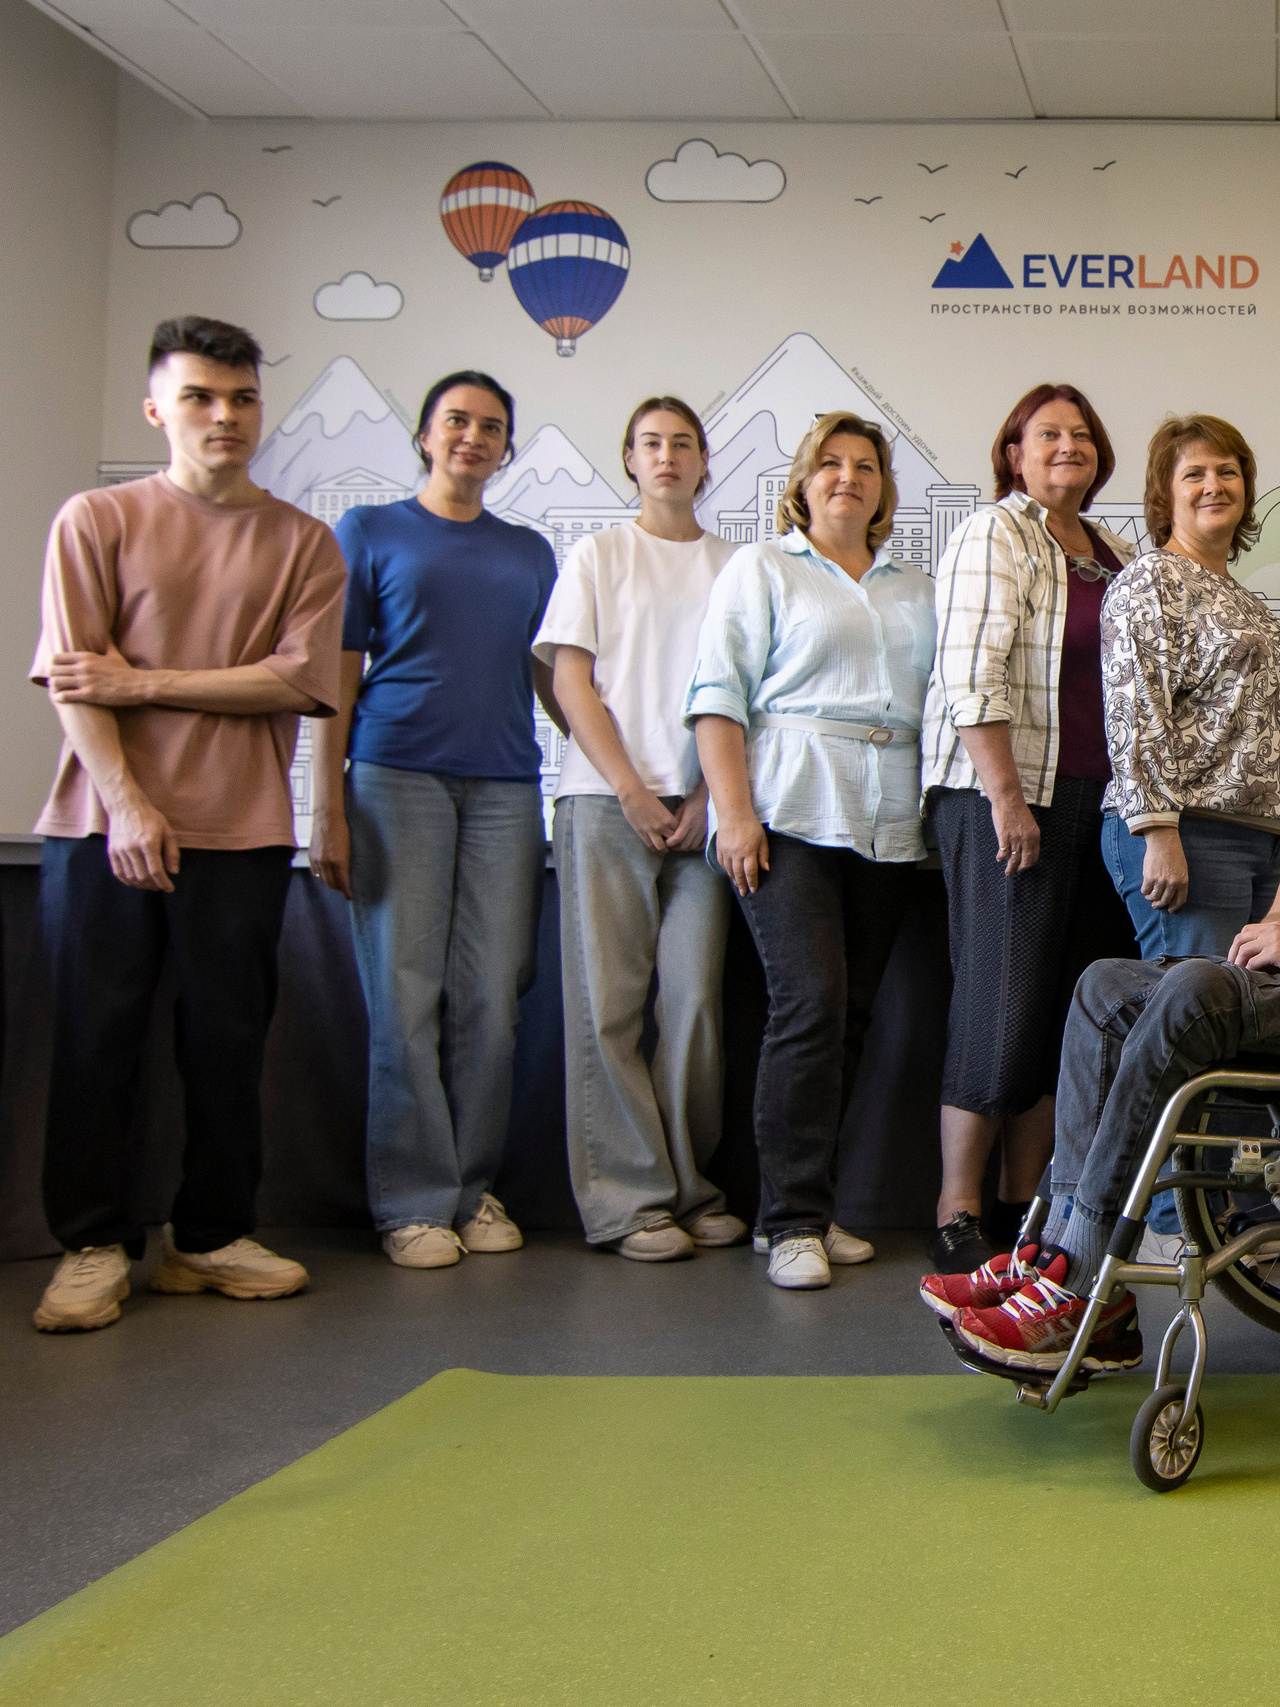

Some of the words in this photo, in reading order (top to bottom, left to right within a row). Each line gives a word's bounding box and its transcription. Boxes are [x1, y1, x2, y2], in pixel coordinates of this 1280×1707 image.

[1022, 254, 1260, 289] EVERLAND
[930, 303, 1053, 315] ПРОСТРАНСТВО
[1059, 303, 1122, 316] РАВНЫХ
[1127, 302, 1258, 316] ВОЗМОЖНОСТЕЙ
